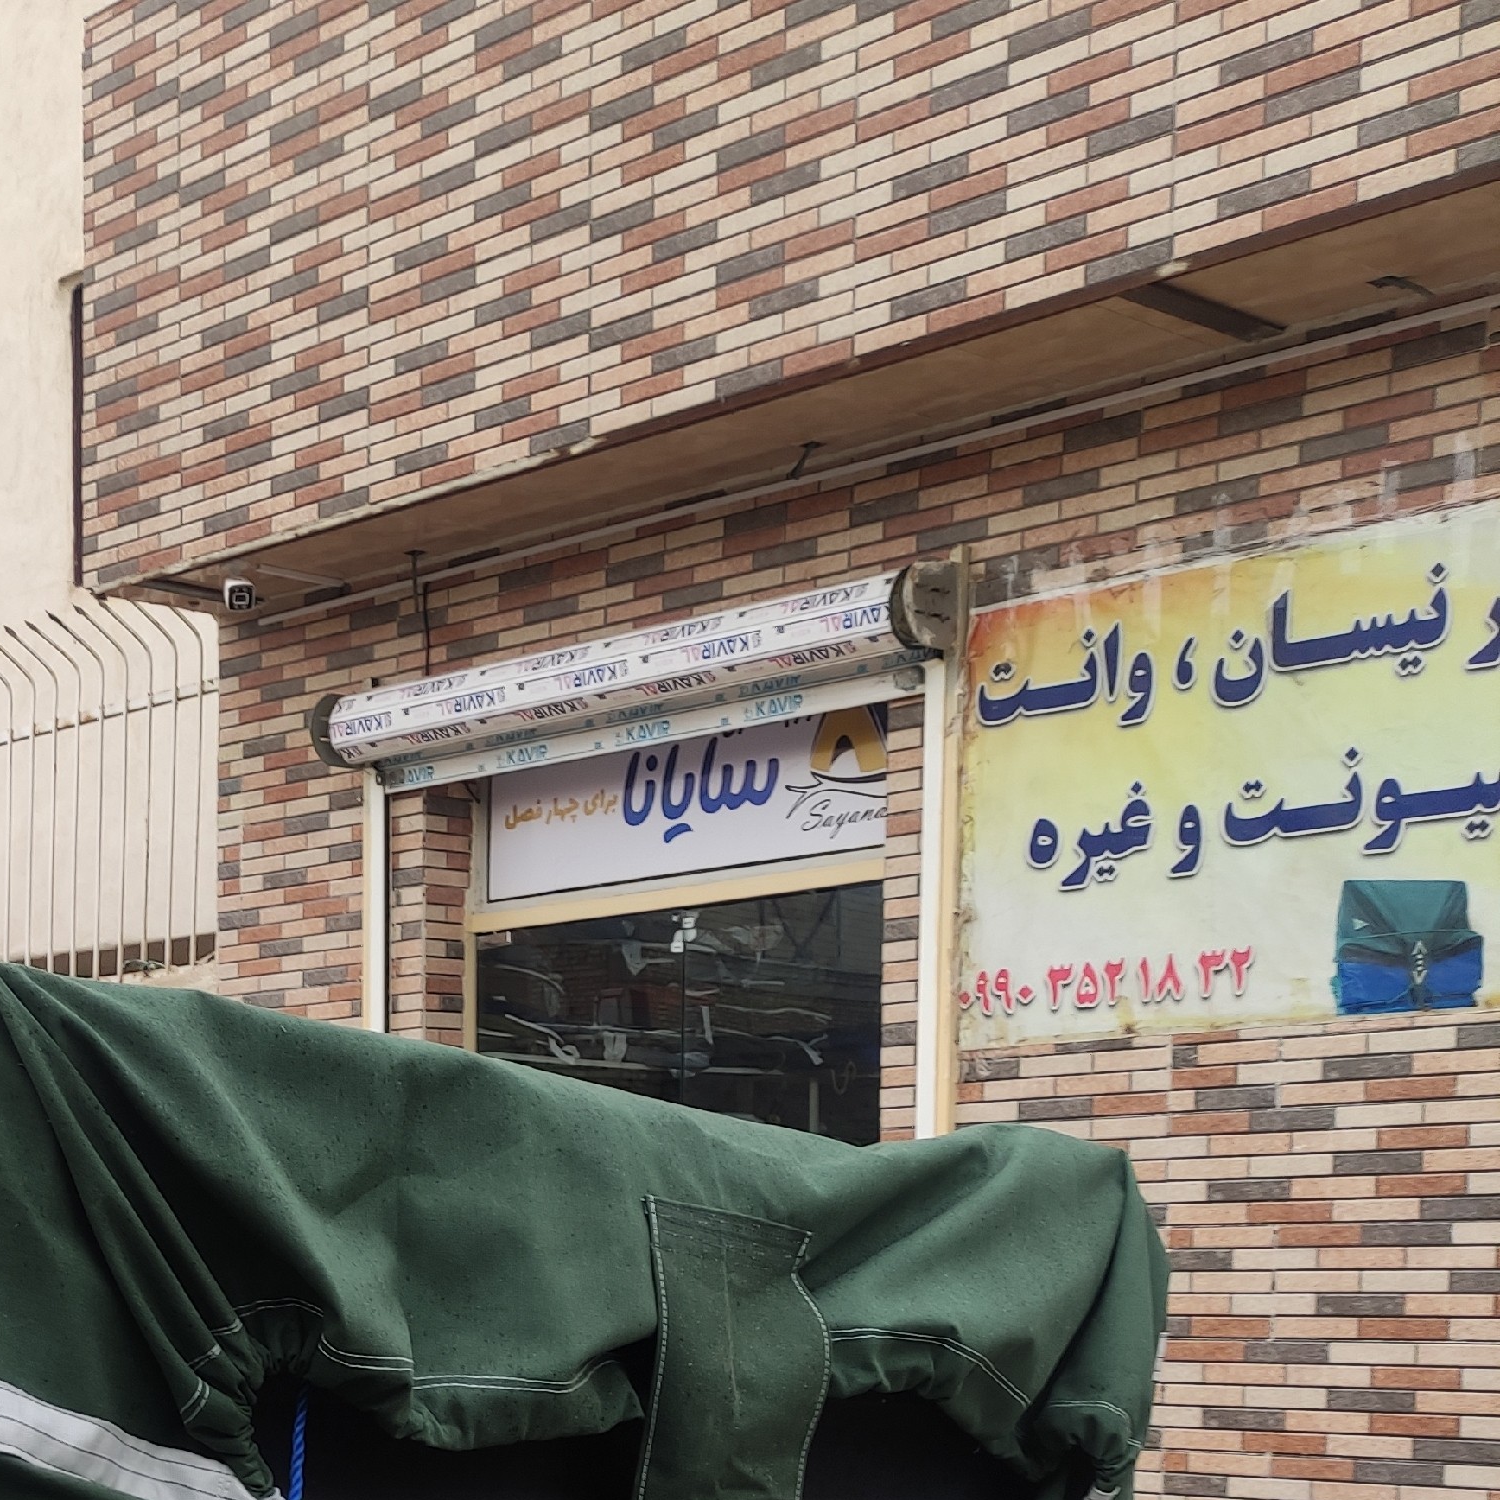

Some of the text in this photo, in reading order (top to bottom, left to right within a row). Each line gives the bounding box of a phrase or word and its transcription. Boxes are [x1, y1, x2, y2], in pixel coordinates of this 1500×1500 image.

[975, 620, 1154, 727] وانت
[504, 789, 618, 829] برای چهار فصل
[623, 737, 779, 843] سایانا
[801, 799, 888, 839] Sayana
[1026, 781, 1155, 892] غیره
[1047, 956, 1126, 1012] ۳۵۲
[1138, 952, 1185, 1003] ۱۸
[1197, 944, 1257, 998] ۳۲
